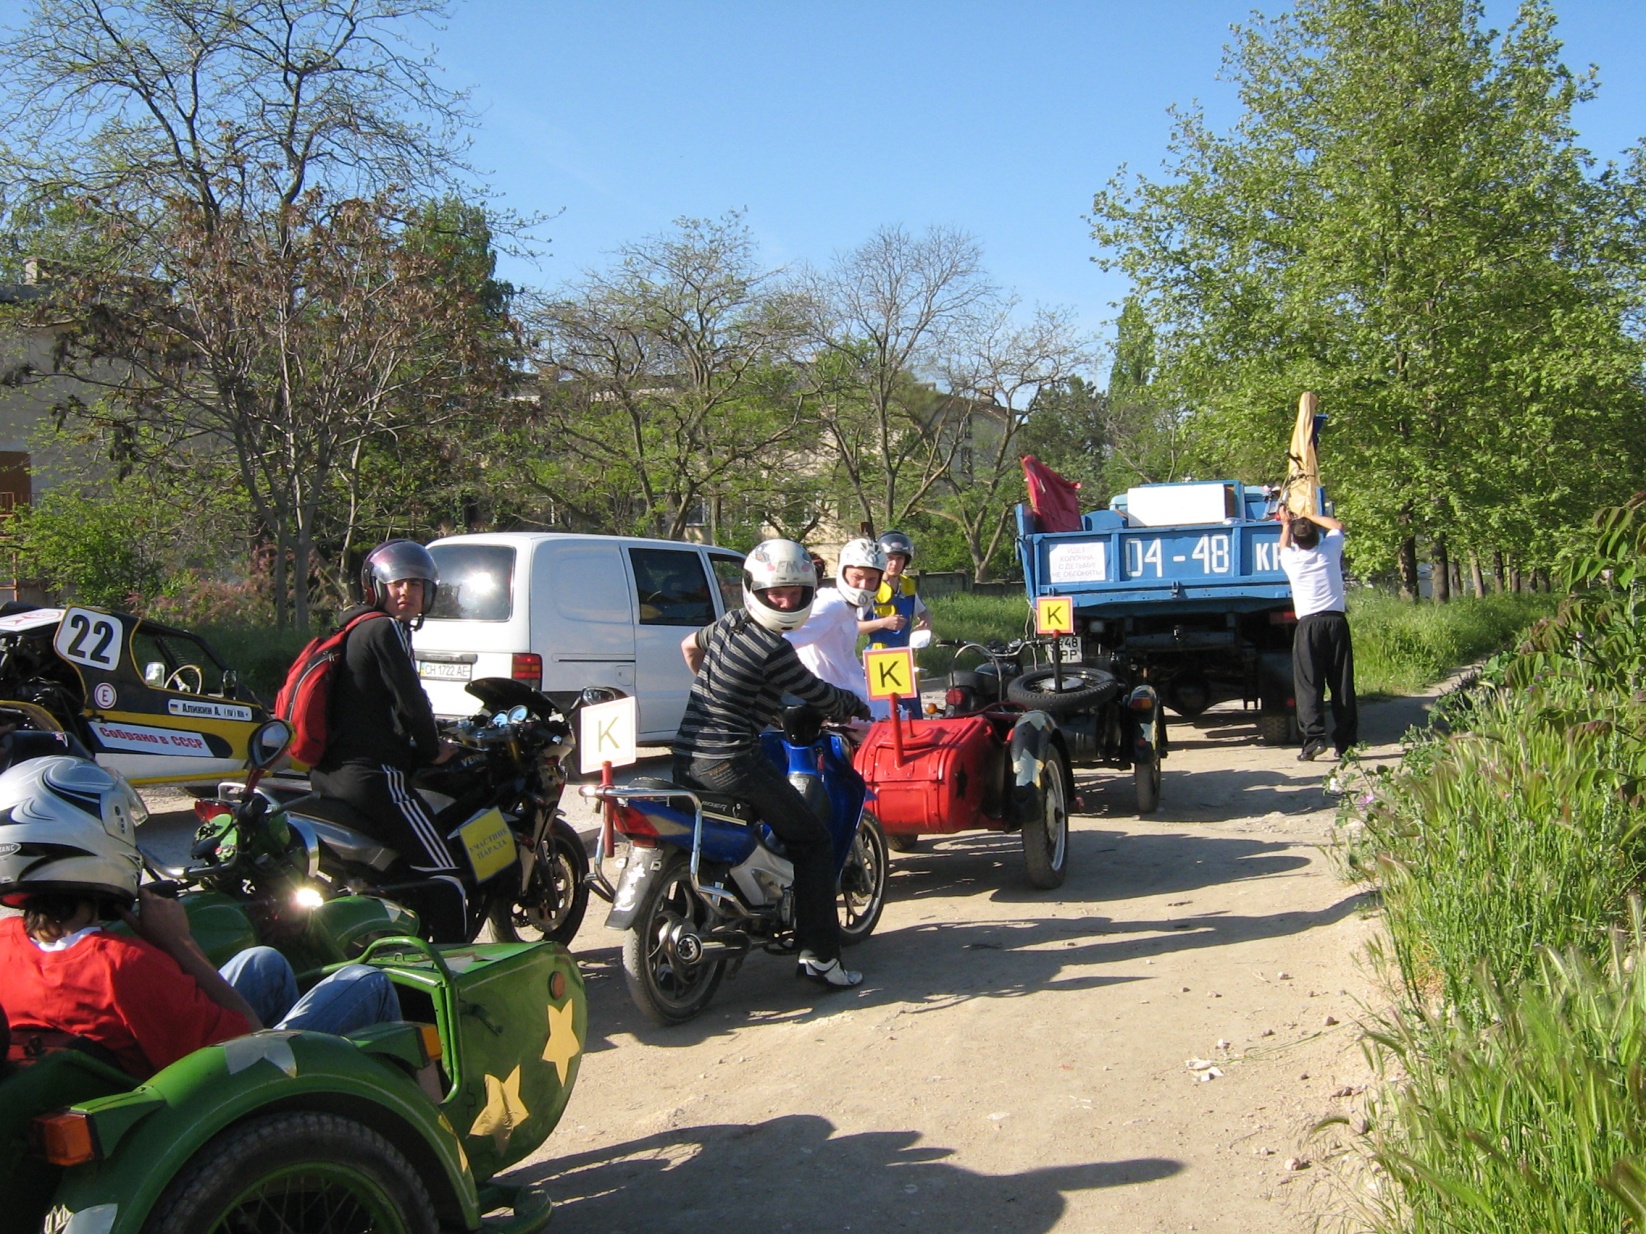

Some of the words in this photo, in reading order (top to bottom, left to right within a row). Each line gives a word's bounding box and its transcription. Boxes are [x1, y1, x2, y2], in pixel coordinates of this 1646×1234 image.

[1047, 606, 1063, 625] К
[67, 614, 114, 664] 22
[438, 665, 455, 676] 1722
[879, 660, 902, 688] К
[102, 689, 110, 702] E
[99, 726, 158, 744] Собрано
[159, 735, 169, 745] в
[170, 735, 203, 749] СССР
[598, 715, 620, 753] К
